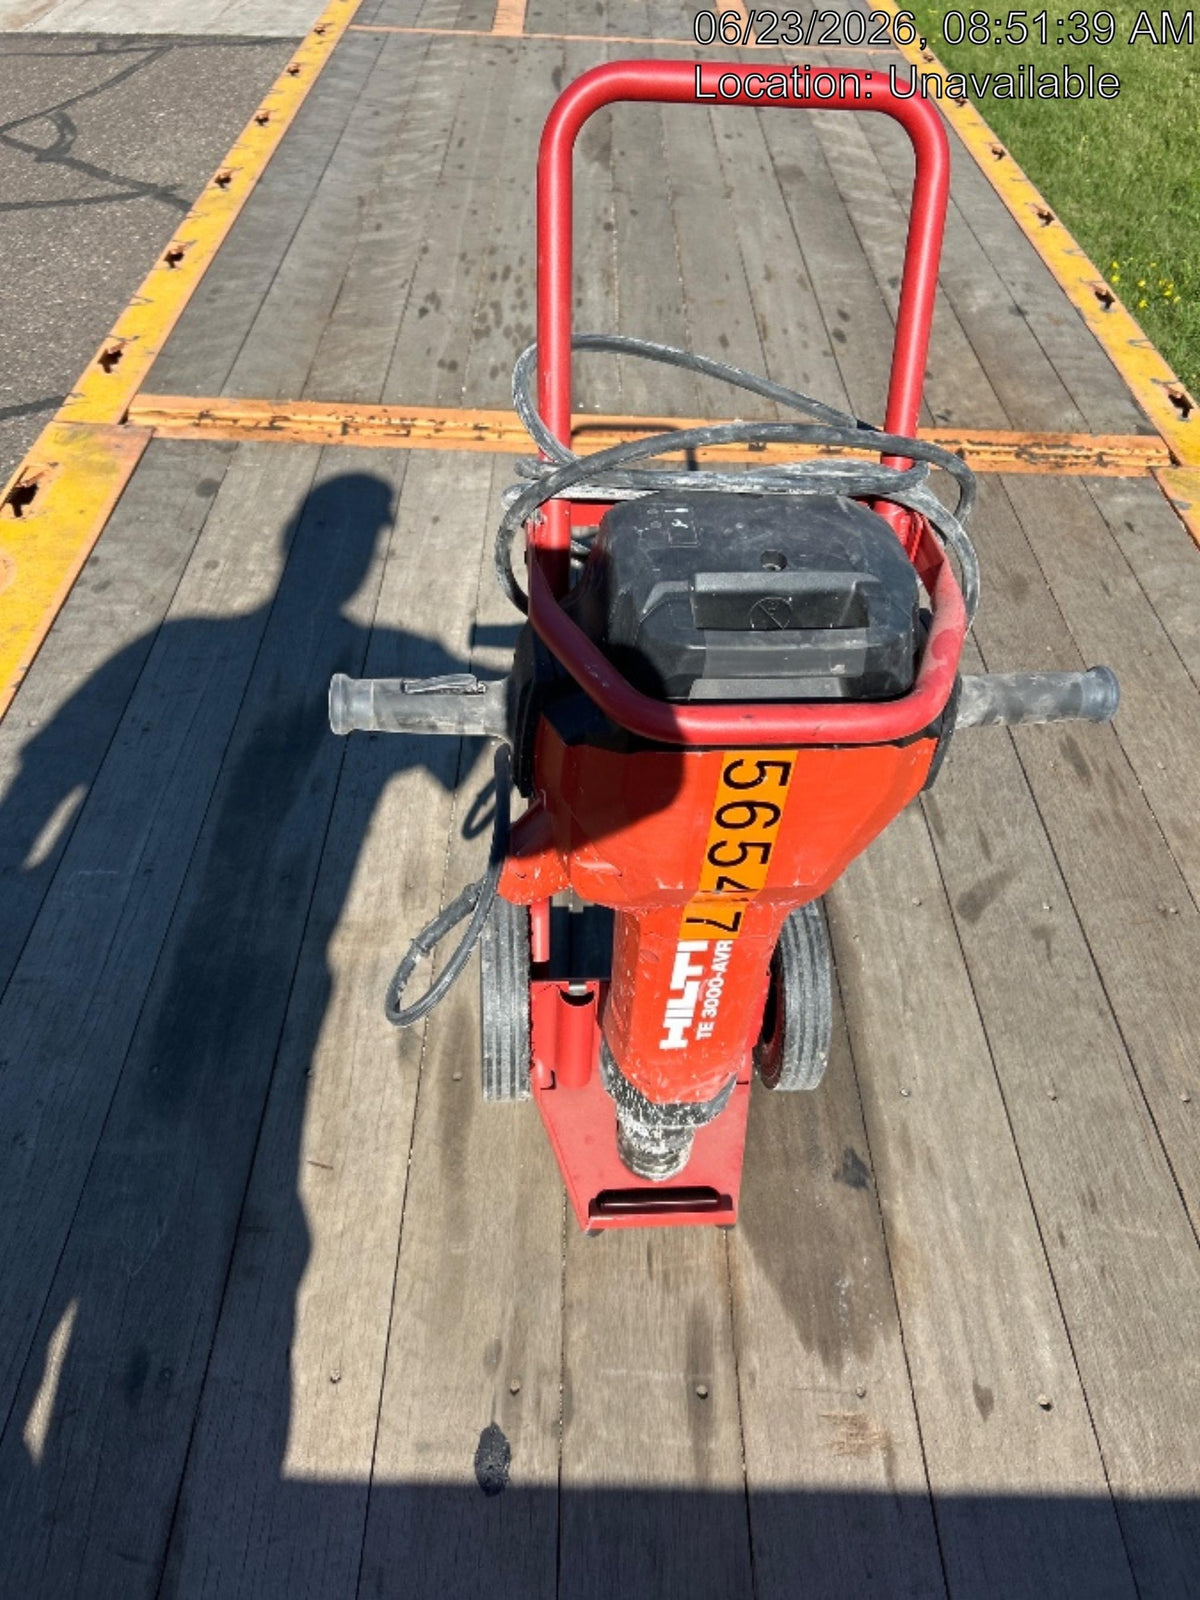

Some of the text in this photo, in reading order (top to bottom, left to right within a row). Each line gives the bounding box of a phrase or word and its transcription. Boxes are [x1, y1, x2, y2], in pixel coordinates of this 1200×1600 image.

[659, 940, 709, 1050] HILTI
[696, 939, 734, 1041] TE 3000-AVR
